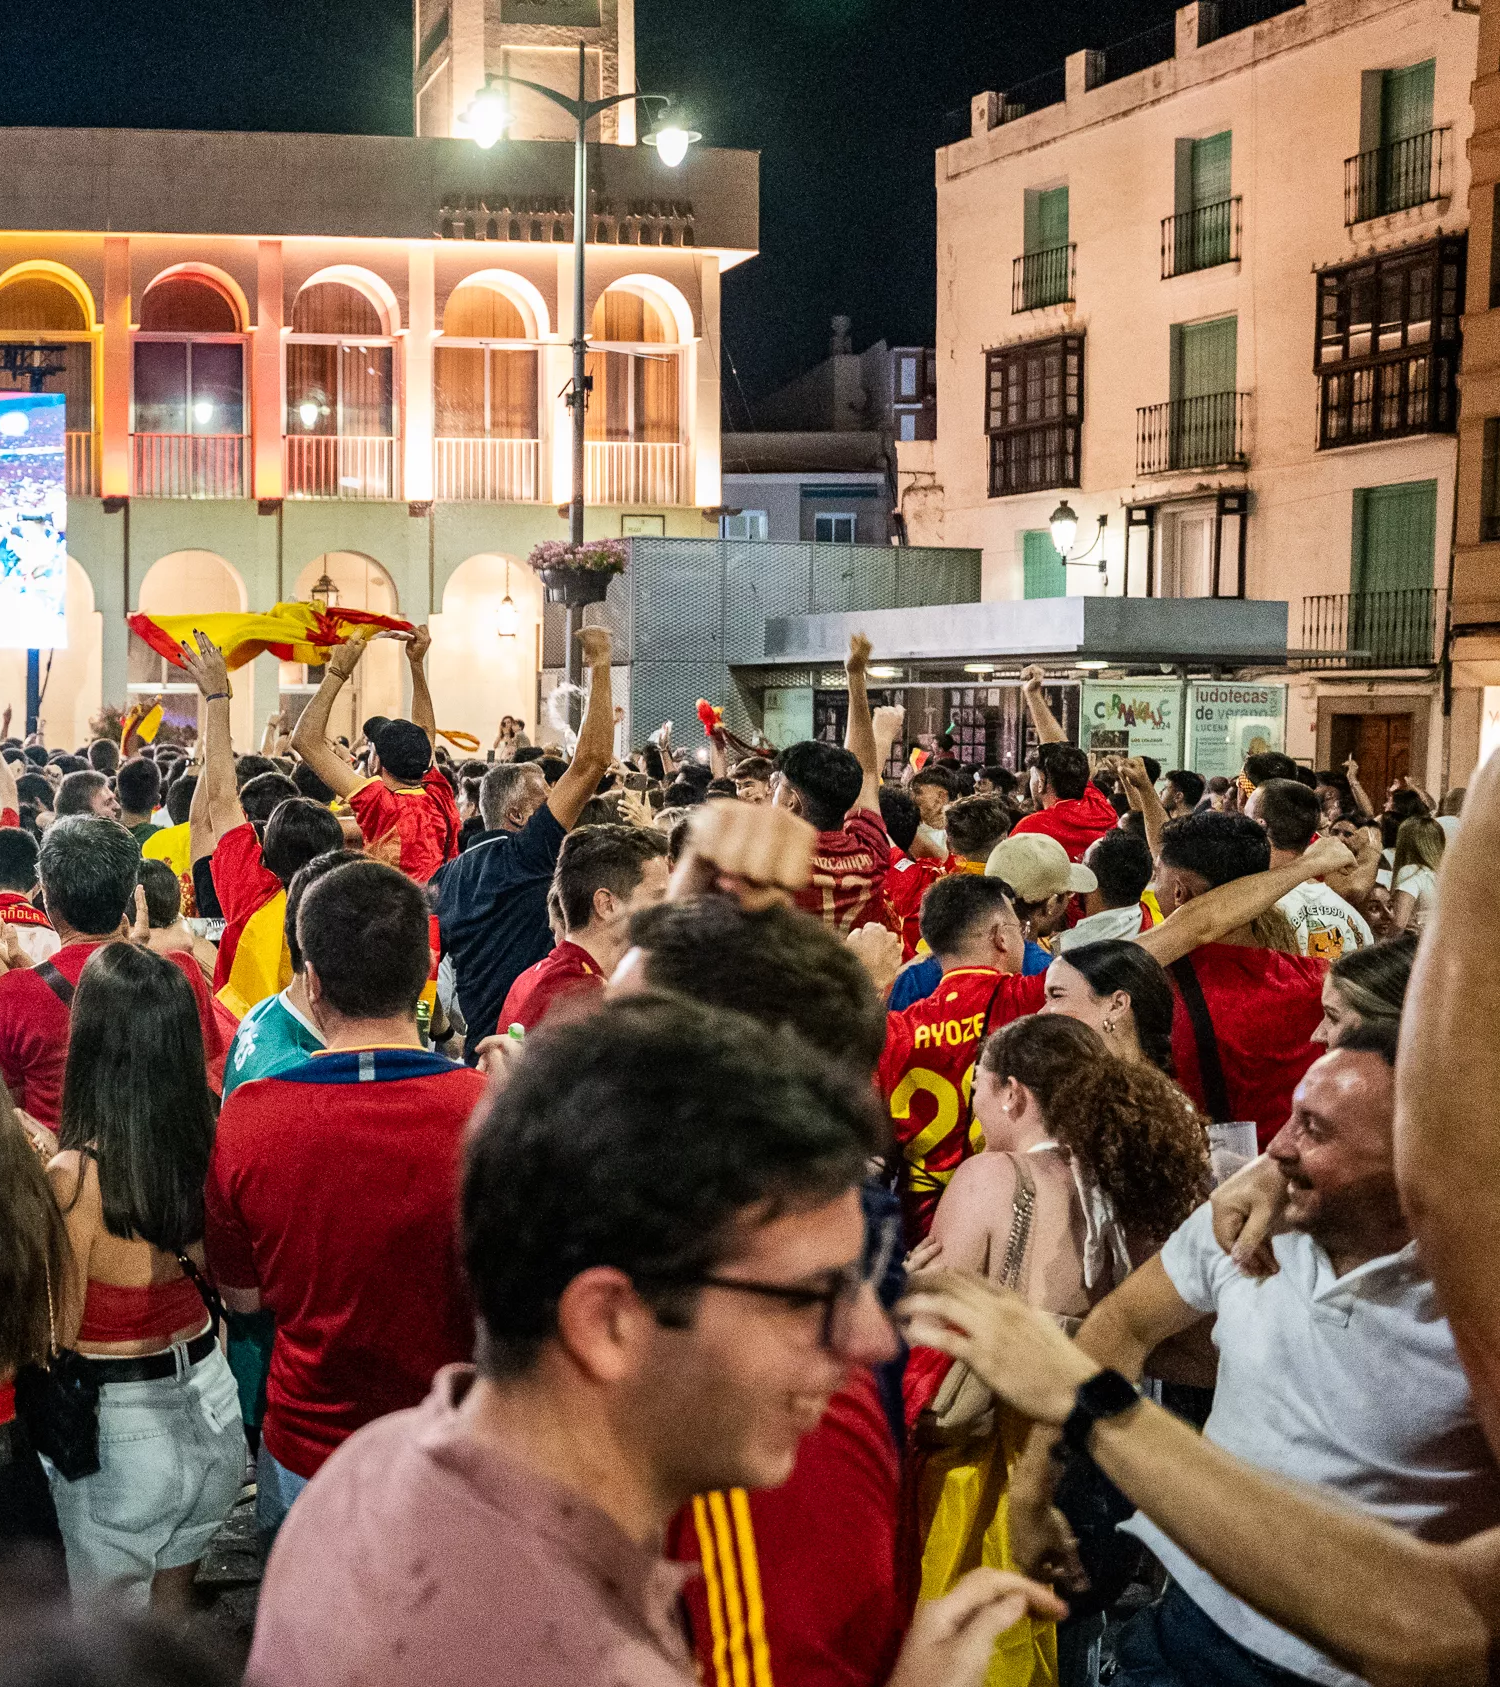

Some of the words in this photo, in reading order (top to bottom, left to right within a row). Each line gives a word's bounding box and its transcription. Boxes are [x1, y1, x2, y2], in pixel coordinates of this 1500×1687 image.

[1195, 687, 1269, 704] ludotecas
[1195, 705, 1214, 720] de
[1217, 708, 1268, 720] verano
[1196, 723, 1229, 732] LUCENA
[914, 1011, 986, 1050] AYOZE
